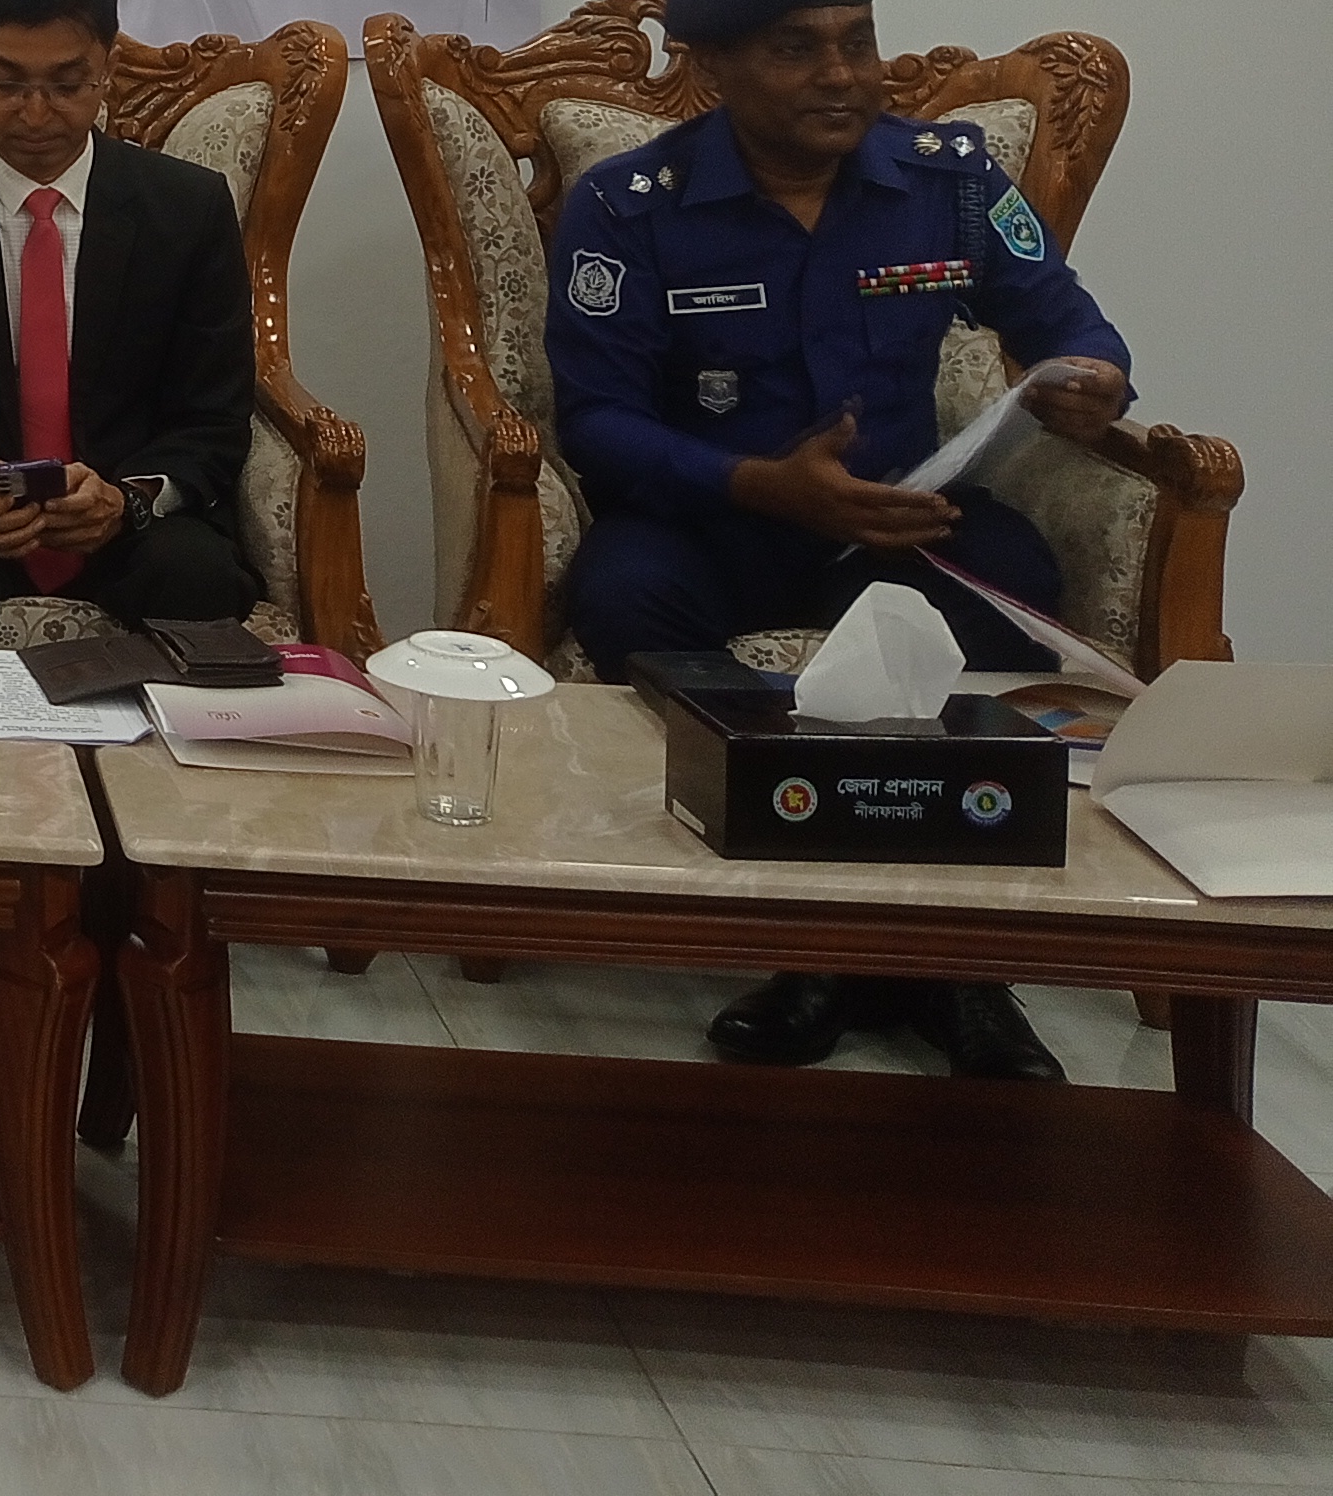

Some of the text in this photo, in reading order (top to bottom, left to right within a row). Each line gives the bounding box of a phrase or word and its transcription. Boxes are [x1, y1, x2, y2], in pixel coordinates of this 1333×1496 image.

[836, 776, 881, 797] জেলা
[884, 777, 946, 798] প্রশাসন
[852, 799, 926, 821] নীলফামারী
